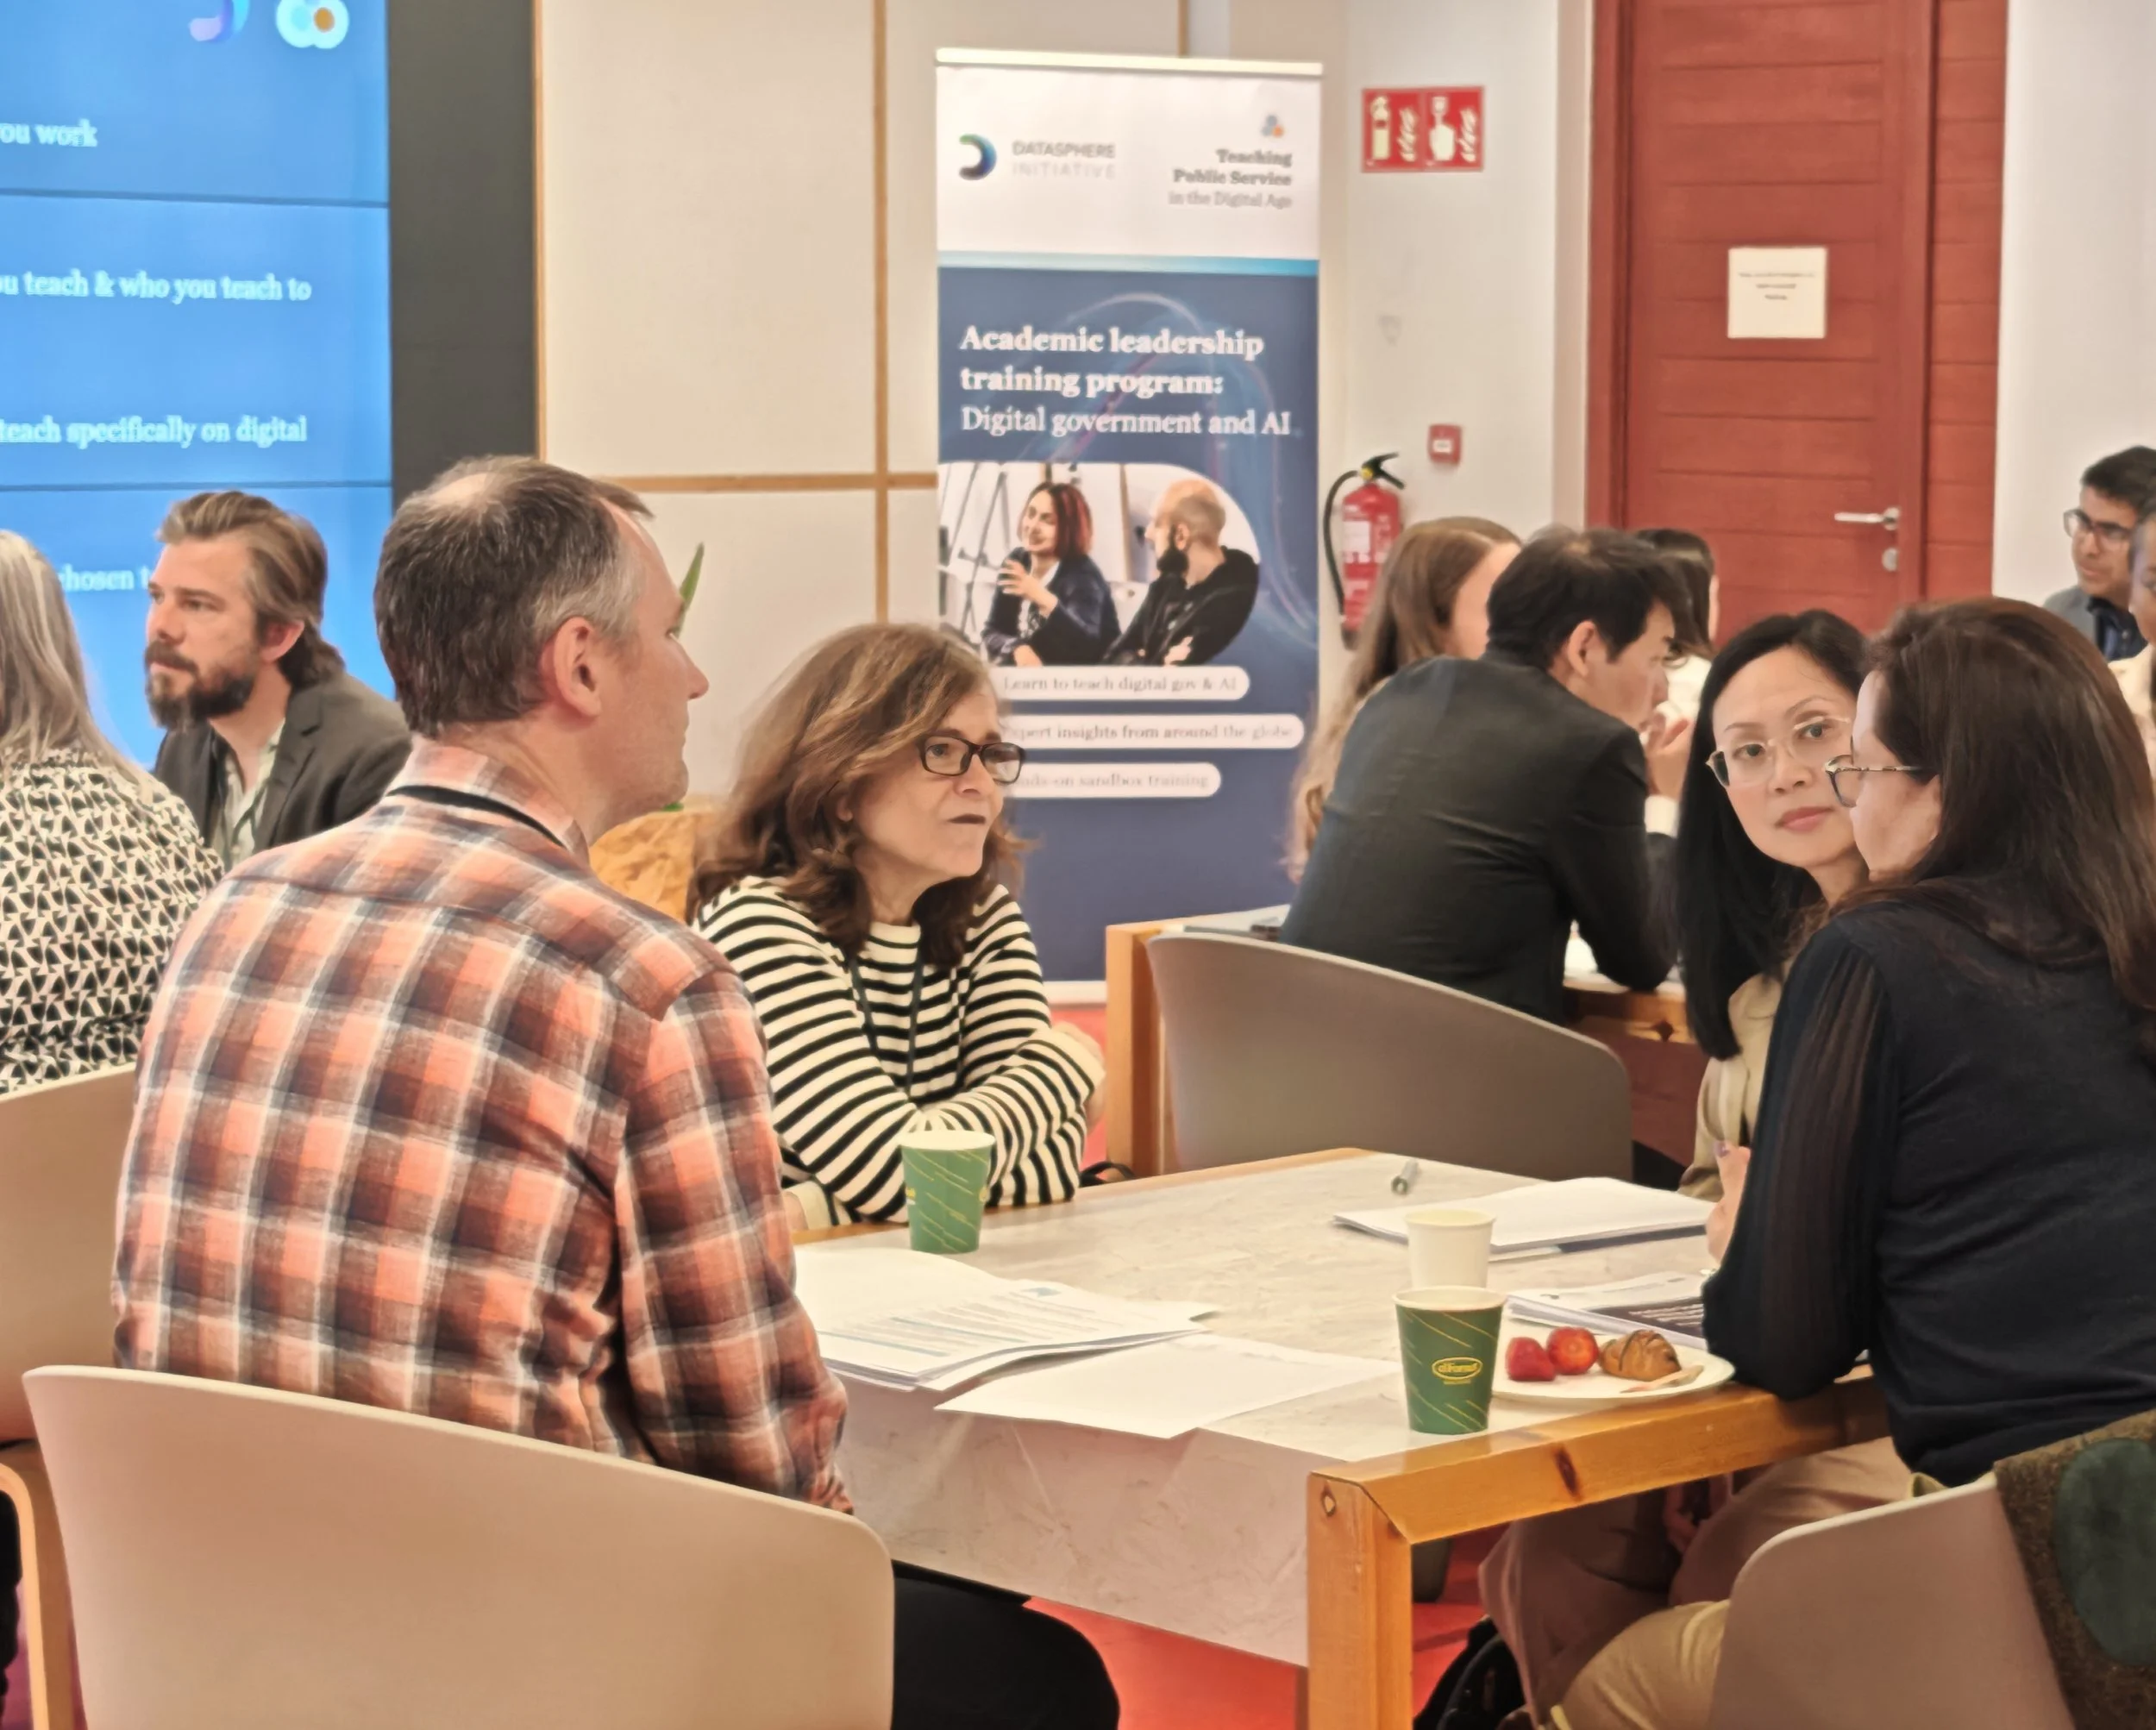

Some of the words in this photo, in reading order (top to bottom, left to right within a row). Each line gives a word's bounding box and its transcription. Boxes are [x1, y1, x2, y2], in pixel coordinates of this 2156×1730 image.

[0, 122, 30, 145] ou
[34, 118, 98, 147] work
[1012, 140, 1116, 159] DATASPHERE
[1216, 148, 1292, 167] Teaching
[1173, 168, 1226, 184] Public
[1230, 171, 1292, 185] Service
[1187, 190, 1211, 205] the
[23, 268, 89, 297] teach
[94, 270, 114, 297] &
[118, 269, 170, 298] who
[172, 278, 216, 304] you
[220, 273, 283, 300] teach
[287, 278, 312, 301] to
[960, 325, 1104, 353] Academic
[1109, 327, 1264, 360] leadership
[961, 366, 1080, 397] training
[1086, 372, 1224, 399] program:
[962, 406, 1045, 436] Digital
[1051, 411, 1201, 438] government
[1208, 410, 1255, 435] and
[1262, 411, 1291, 436] AI
[66, 415, 197, 449] specifically
[201, 423, 230, 442] on
[235, 415, 307, 448] digital
[1004, 676, 1048, 690] Learn
[1054, 677, 1069, 690] to
[1073, 676, 1114, 690] teach
[1119, 676, 1166, 693] digital
[1057, 725, 1118, 741] insights
[1122, 725, 1160, 739] from
[1163, 725, 1218, 739] around
[1223, 725, 1245, 738] the
[1149, 774, 1208, 789] training
